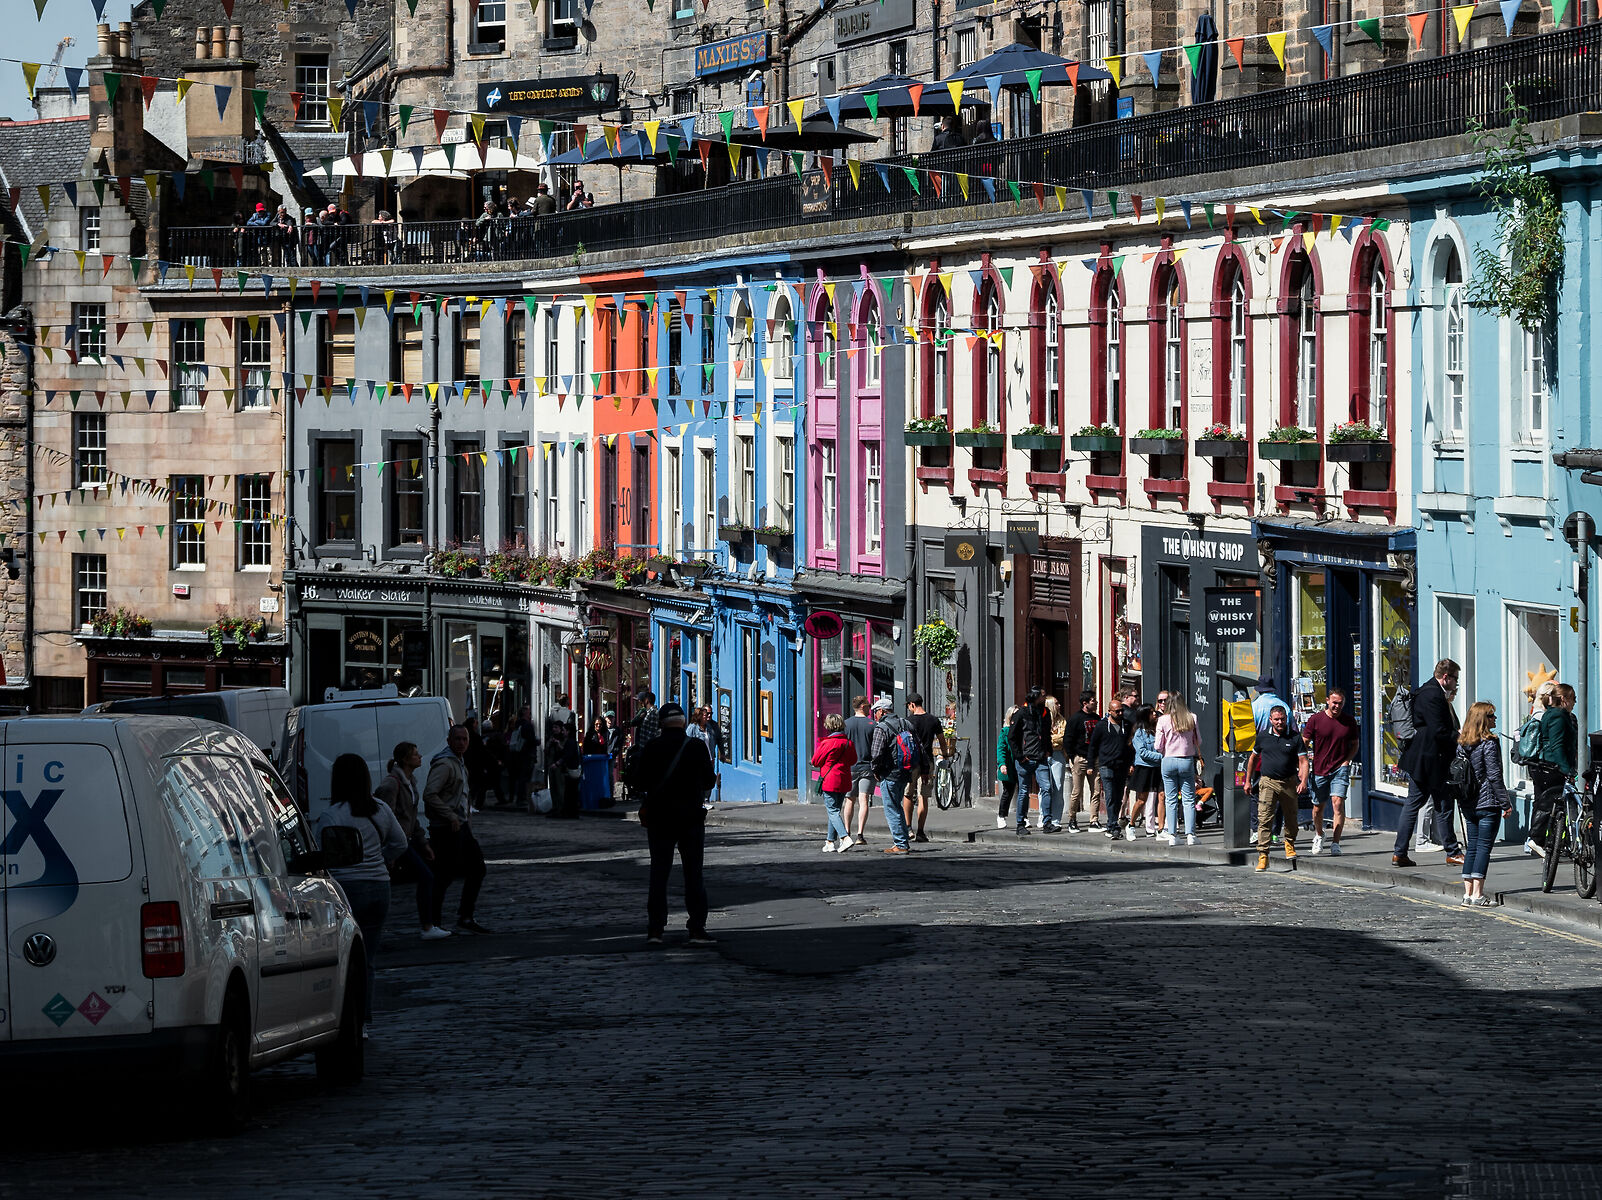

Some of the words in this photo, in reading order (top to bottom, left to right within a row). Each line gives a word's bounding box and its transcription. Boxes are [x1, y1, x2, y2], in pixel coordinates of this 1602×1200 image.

[508, 90, 526, 101] THE
[619, 487, 632, 526] 40
[1162, 537, 1181, 555] THE
[1182, 537, 1217, 560] WHISKY
[1219, 541, 1244, 561] SHOP
[337, 588, 375, 601] Walker
[1220, 598, 1242, 606] THE
[1209, 611, 1253, 622] WHISKY
[1216, 627, 1246, 636] SHOP
[104, 985, 126, 994] TDI
